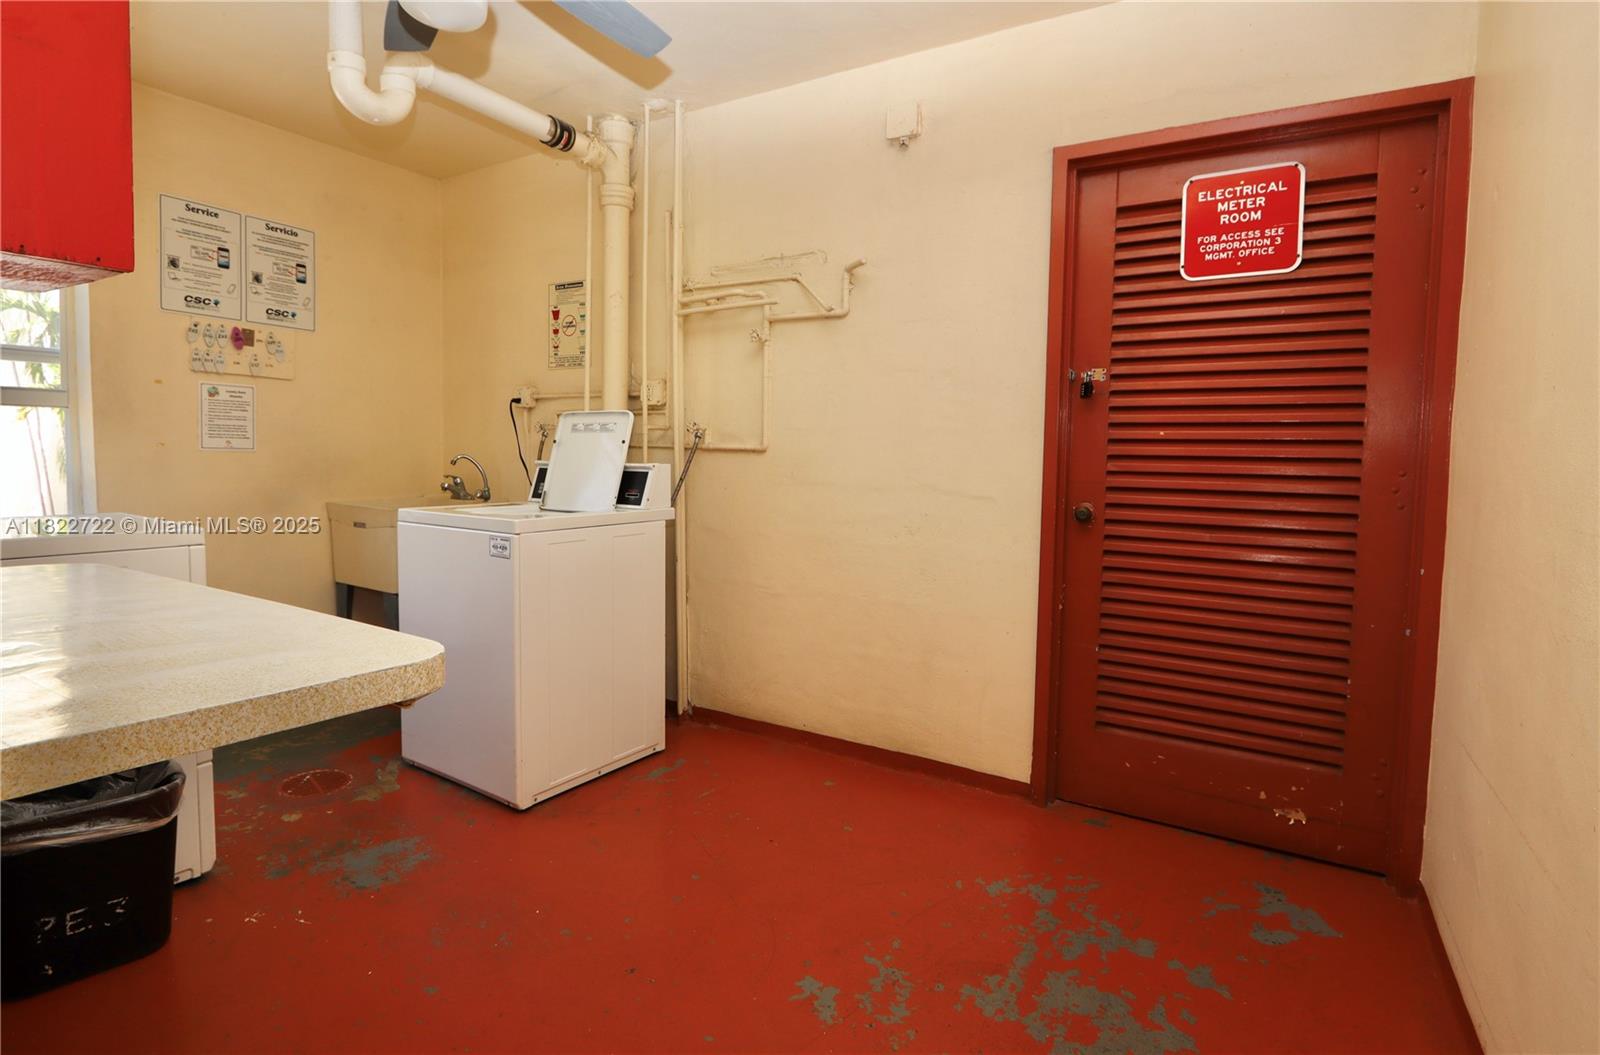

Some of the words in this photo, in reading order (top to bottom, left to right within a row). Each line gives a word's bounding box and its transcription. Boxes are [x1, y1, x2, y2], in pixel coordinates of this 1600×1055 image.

[1198, 181, 1287, 202] ELECTRICAL
[185, 203, 219, 218] Service
[1217, 196, 1265, 212] METER
[1220, 210, 1262, 225] ROOM
[265, 223, 298, 238] Servicio
[1197, 235, 1217, 245] FOR
[1221, 230, 1260, 241] ACCESS
[1265, 227, 1285, 236] SEE
[1199, 238, 1271, 253] CORPORATION
[1274, 236, 1282, 245] 3
[1205, 252, 1235, 261] MGMT.
[1238, 247, 1275, 257] OFFICE
[184, 295, 212, 305] CSC
[265, 308, 290, 318] CSC
